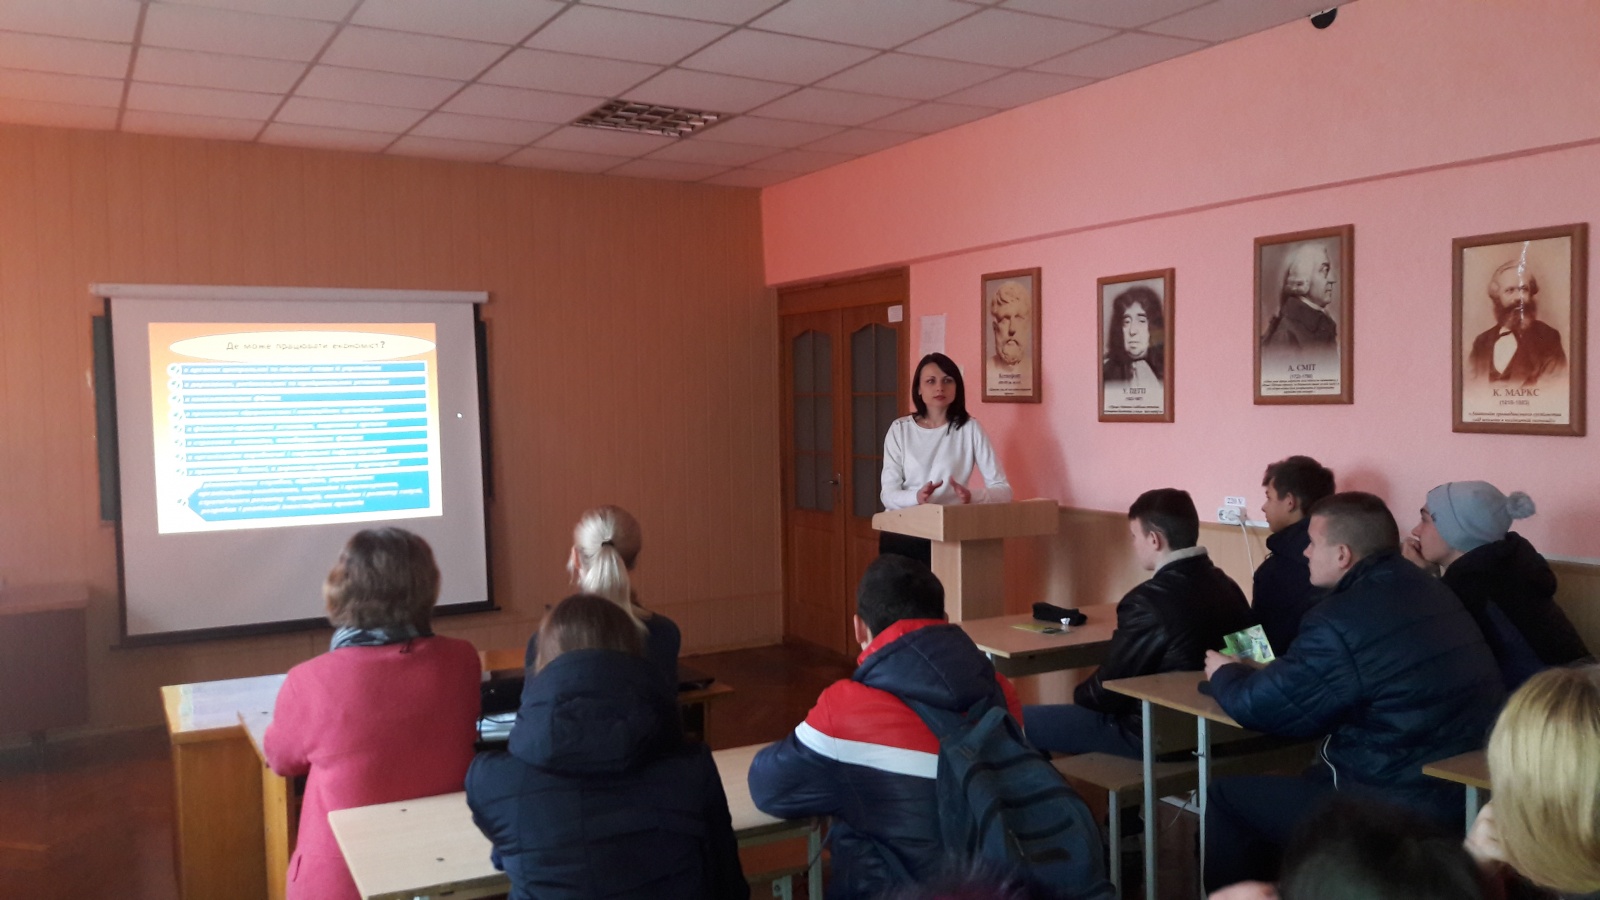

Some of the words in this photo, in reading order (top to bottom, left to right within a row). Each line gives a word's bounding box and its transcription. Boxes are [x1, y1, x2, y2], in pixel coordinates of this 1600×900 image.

[226, 341, 239, 350] Де
[1296, 363, 1317, 371] СМІТ
[1493, 388, 1502, 397] К.
[1504, 388, 1540, 397] МАРКС
